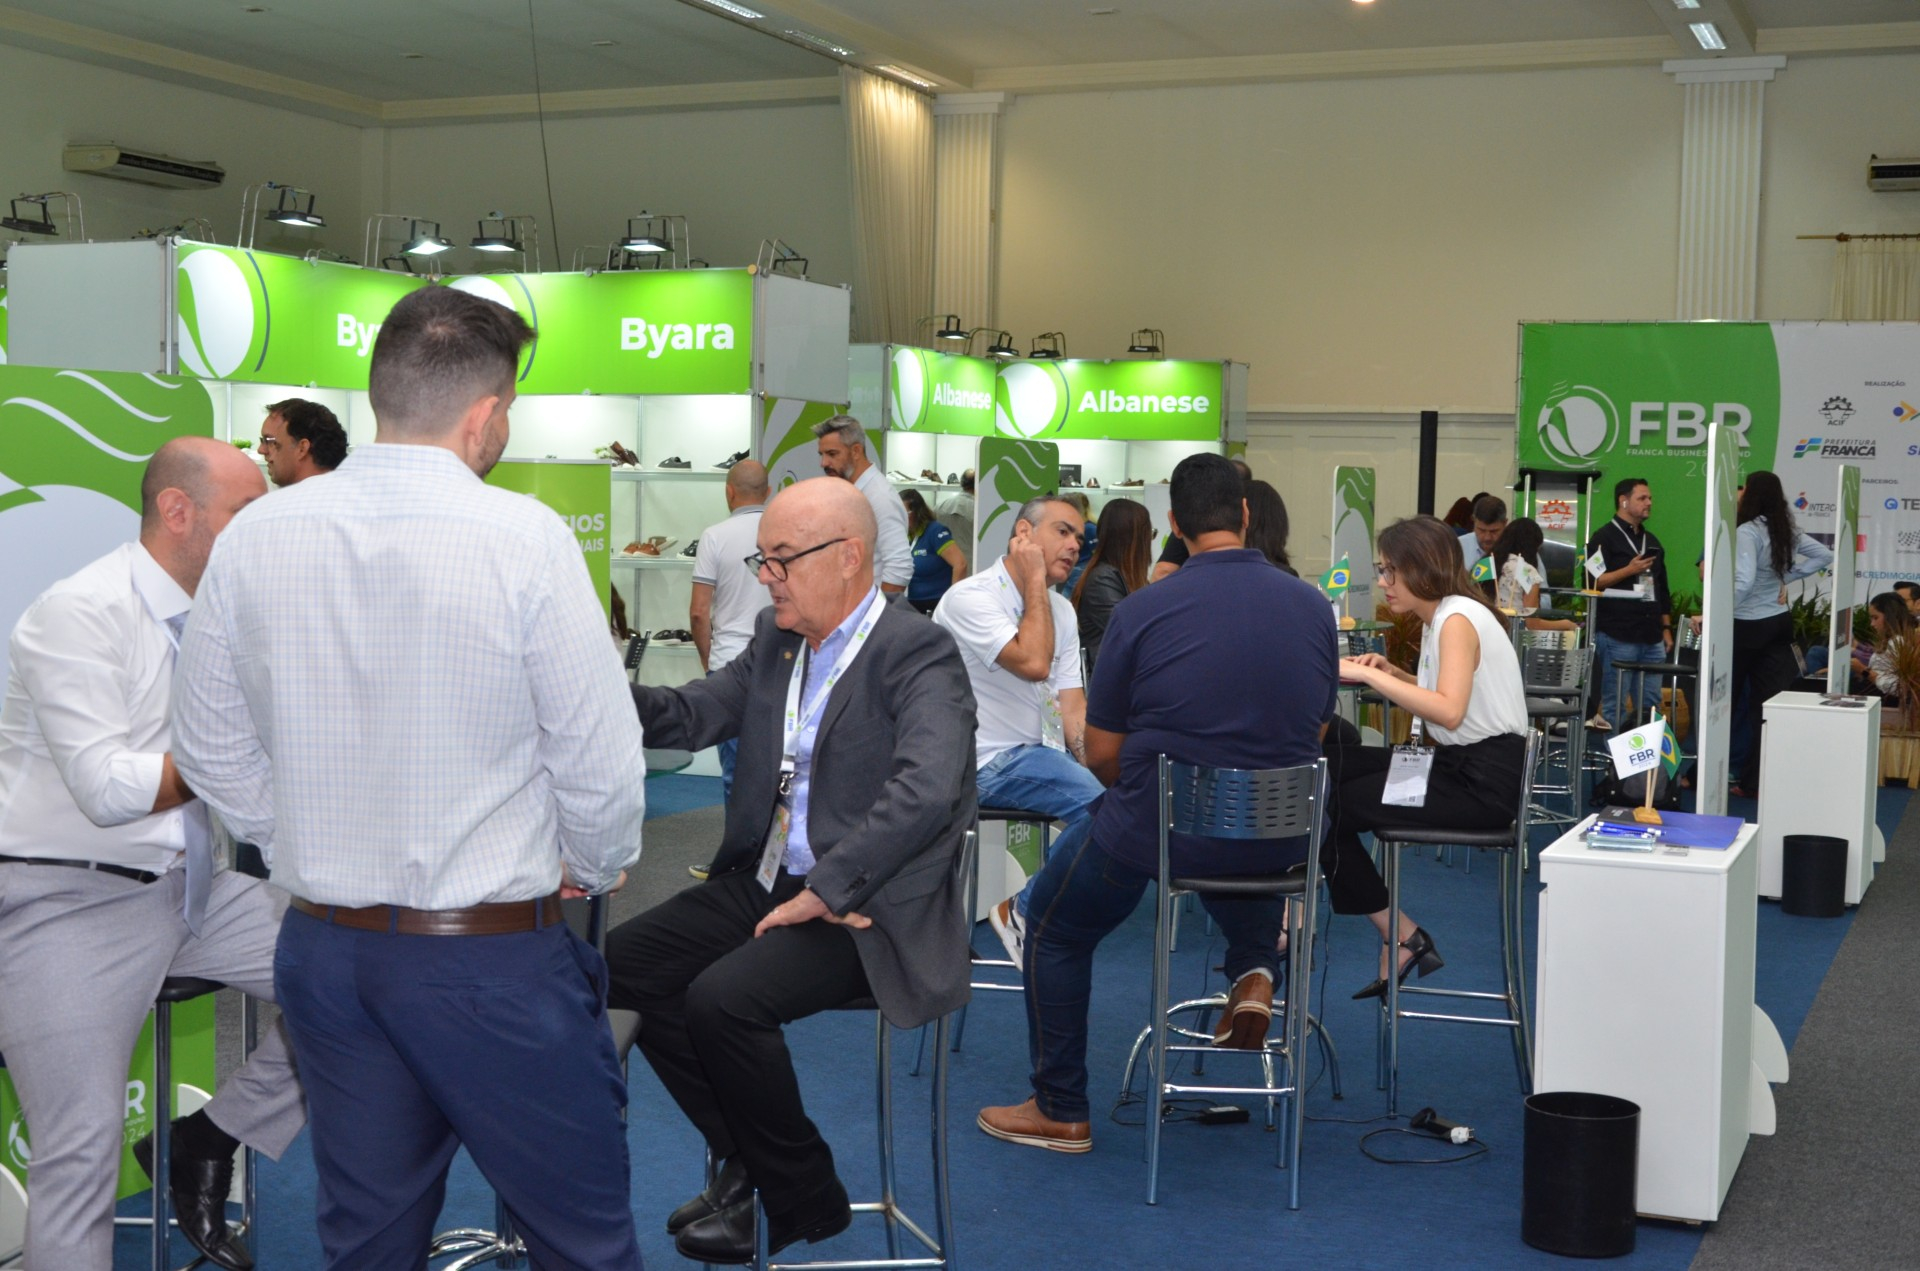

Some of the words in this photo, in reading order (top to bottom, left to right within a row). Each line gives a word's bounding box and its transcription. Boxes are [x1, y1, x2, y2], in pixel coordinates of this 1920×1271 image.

[620, 317, 735, 358] Byara
[932, 383, 992, 410] Albanese
[1077, 390, 1210, 413] Albanese
[1629, 402, 1752, 447] FBR
[1821, 445, 1876, 456] FRANCA
[1824, 438, 1876, 446] PREFEITURA
[1907, 445, 1920, 455] S
[1626, 448, 1664, 457] FRANCA
[1667, 449, 1708, 457] BUSINES
[1808, 503, 1837, 512] INTERC
[1629, 748, 1656, 765] FBR
[1008, 823, 1031, 847] FBR
